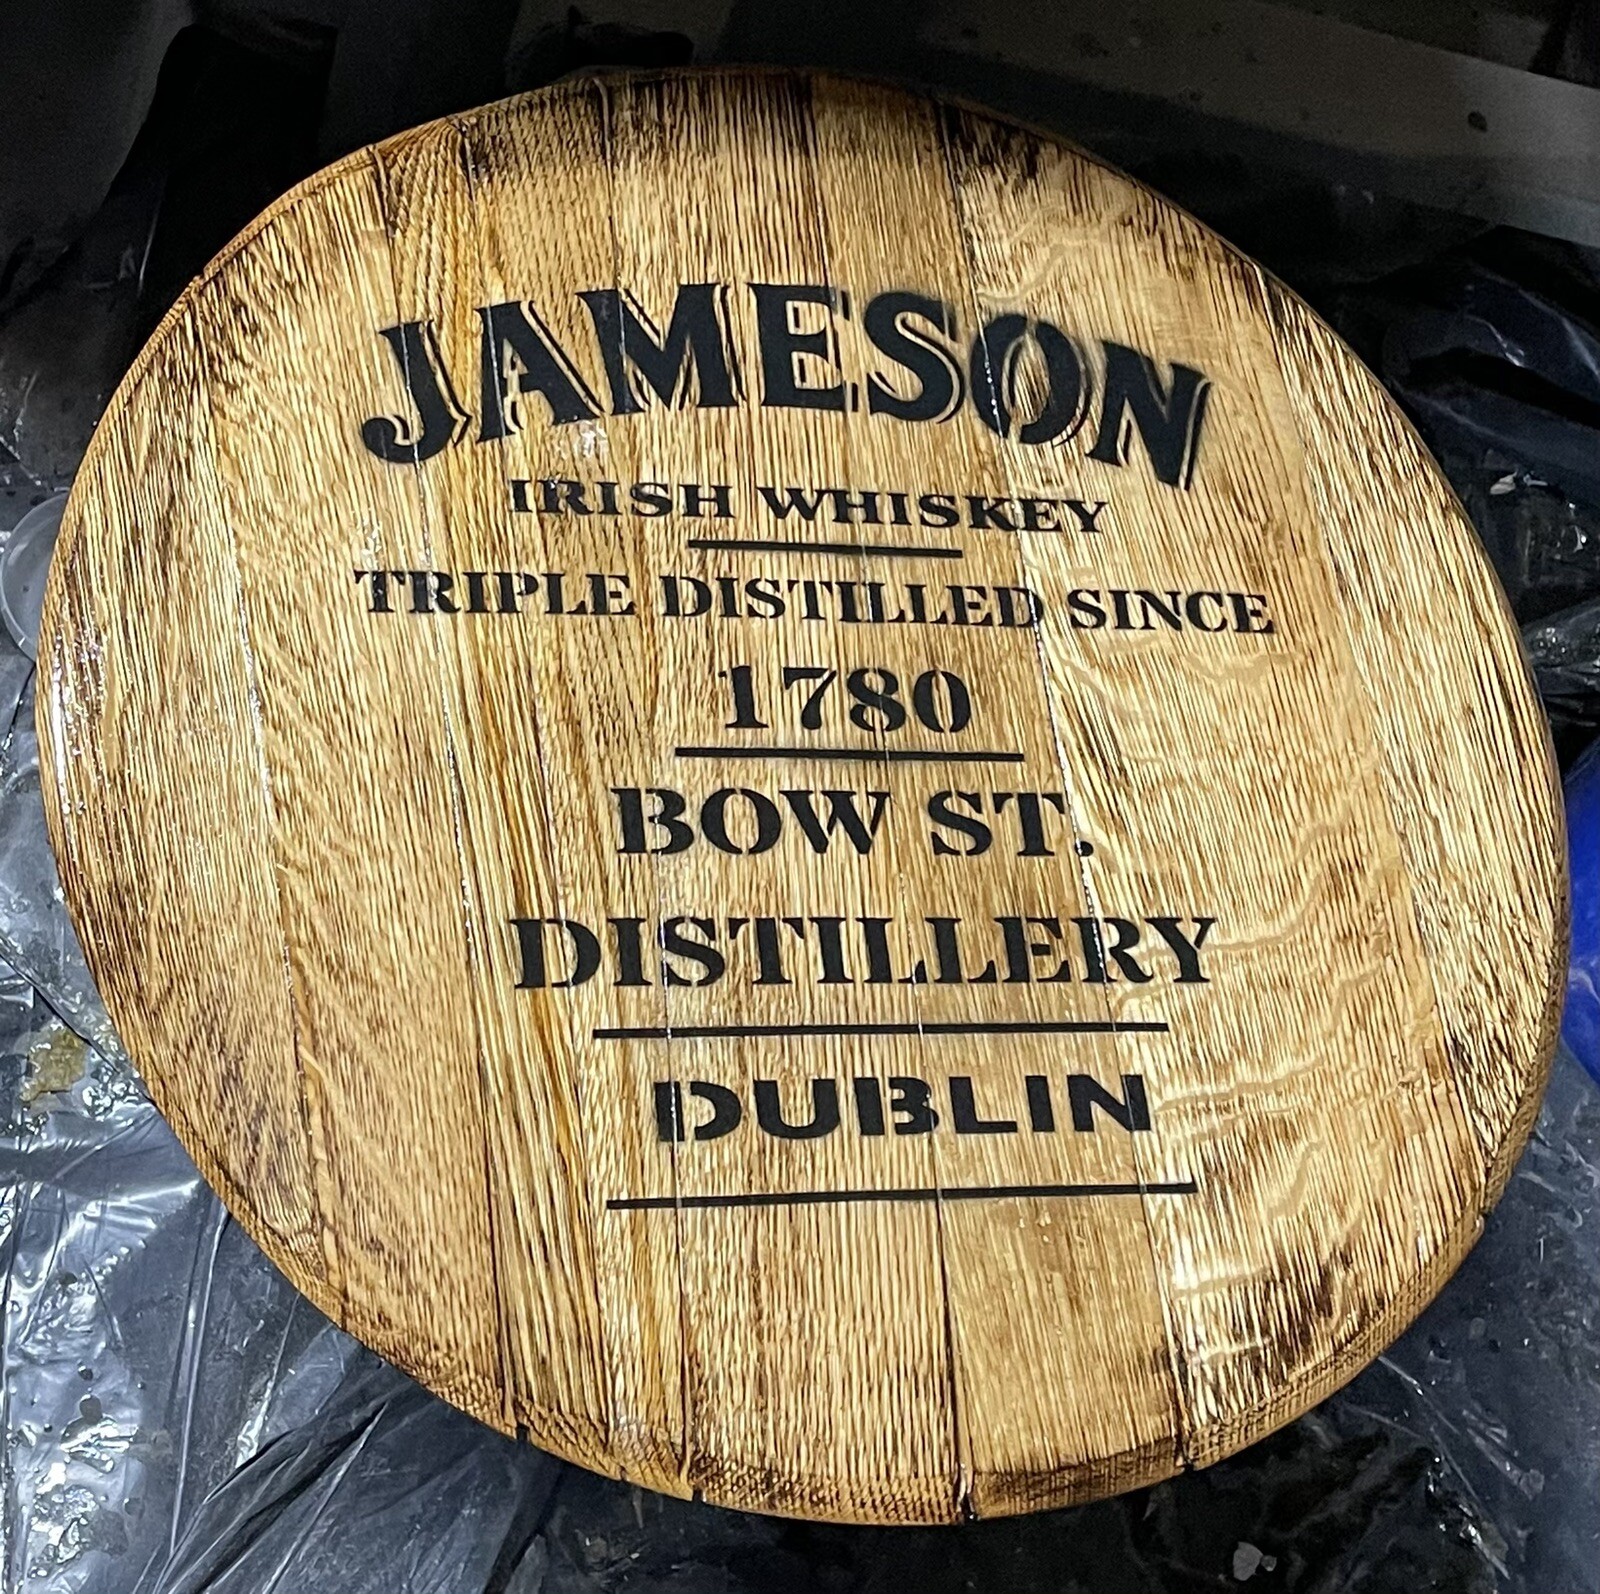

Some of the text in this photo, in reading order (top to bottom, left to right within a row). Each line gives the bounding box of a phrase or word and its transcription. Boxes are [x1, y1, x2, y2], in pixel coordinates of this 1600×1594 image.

[361, 282, 1212, 492] JAMESON
[509, 479, 1109, 533] IRISH WHISKEY
[356, 569, 1276, 634] TRIPLE DISTILLED SINCE
[720, 665, 971, 732] 1780
[611, 786, 1093, 857] BOW ST.
[511, 916, 1216, 988] DISTILLERY
[655, 1073, 1151, 1141] DUBLIN
